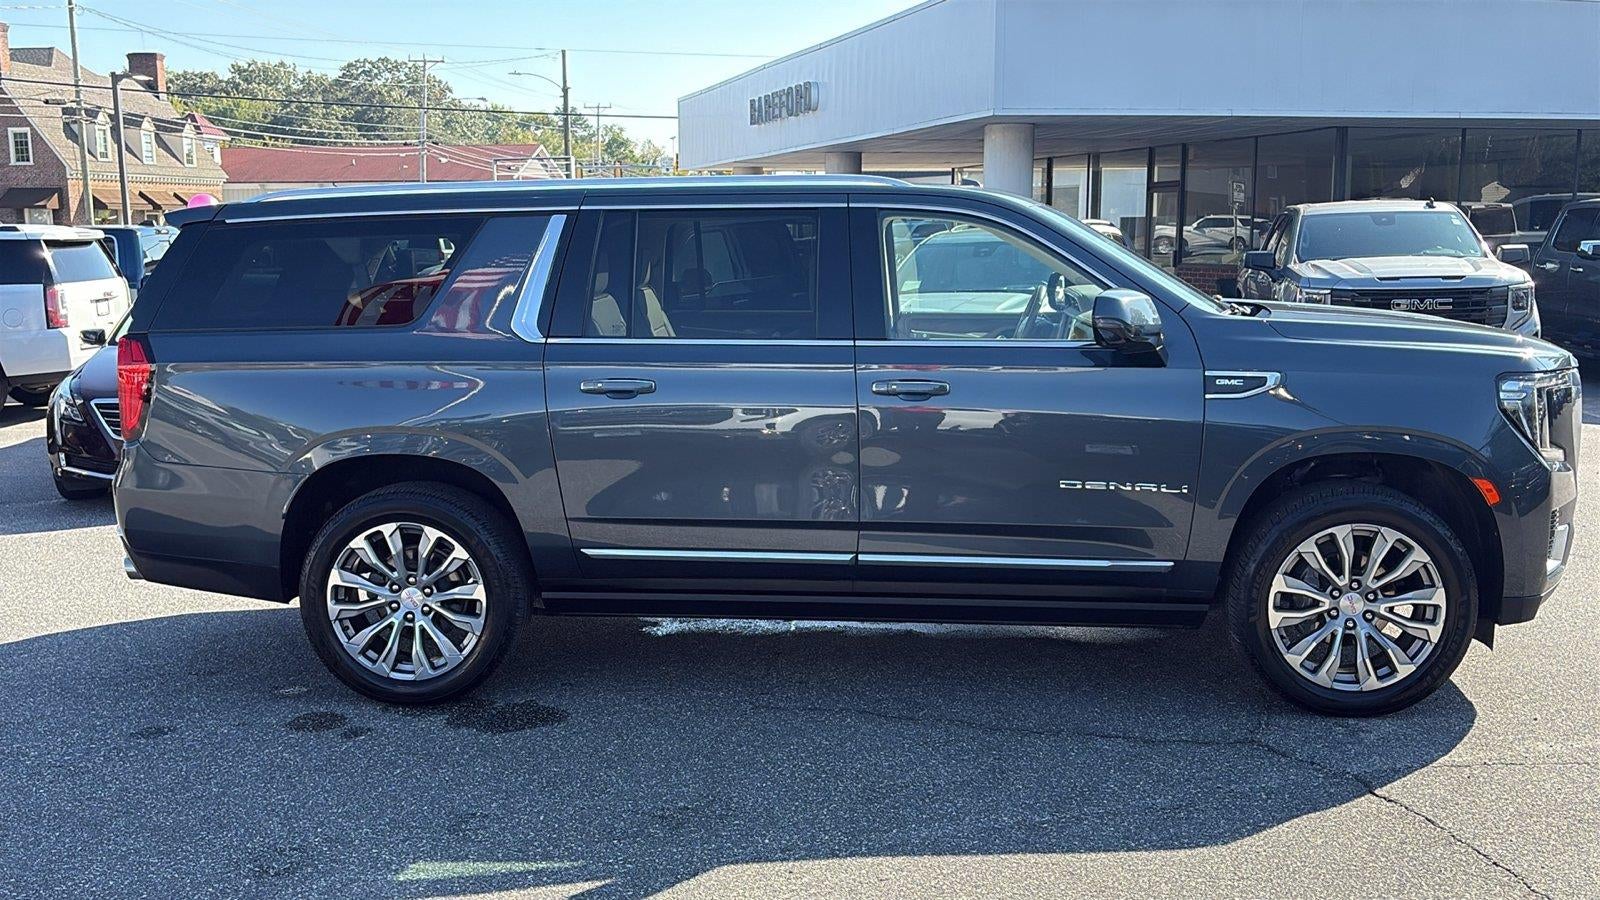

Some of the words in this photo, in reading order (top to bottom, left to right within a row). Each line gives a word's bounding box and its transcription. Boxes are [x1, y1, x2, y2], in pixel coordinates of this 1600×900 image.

[750, 81, 812, 125] BAREFORD
[1391, 298, 1453, 311] GMC
[1059, 480, 1189, 494] DENALI
